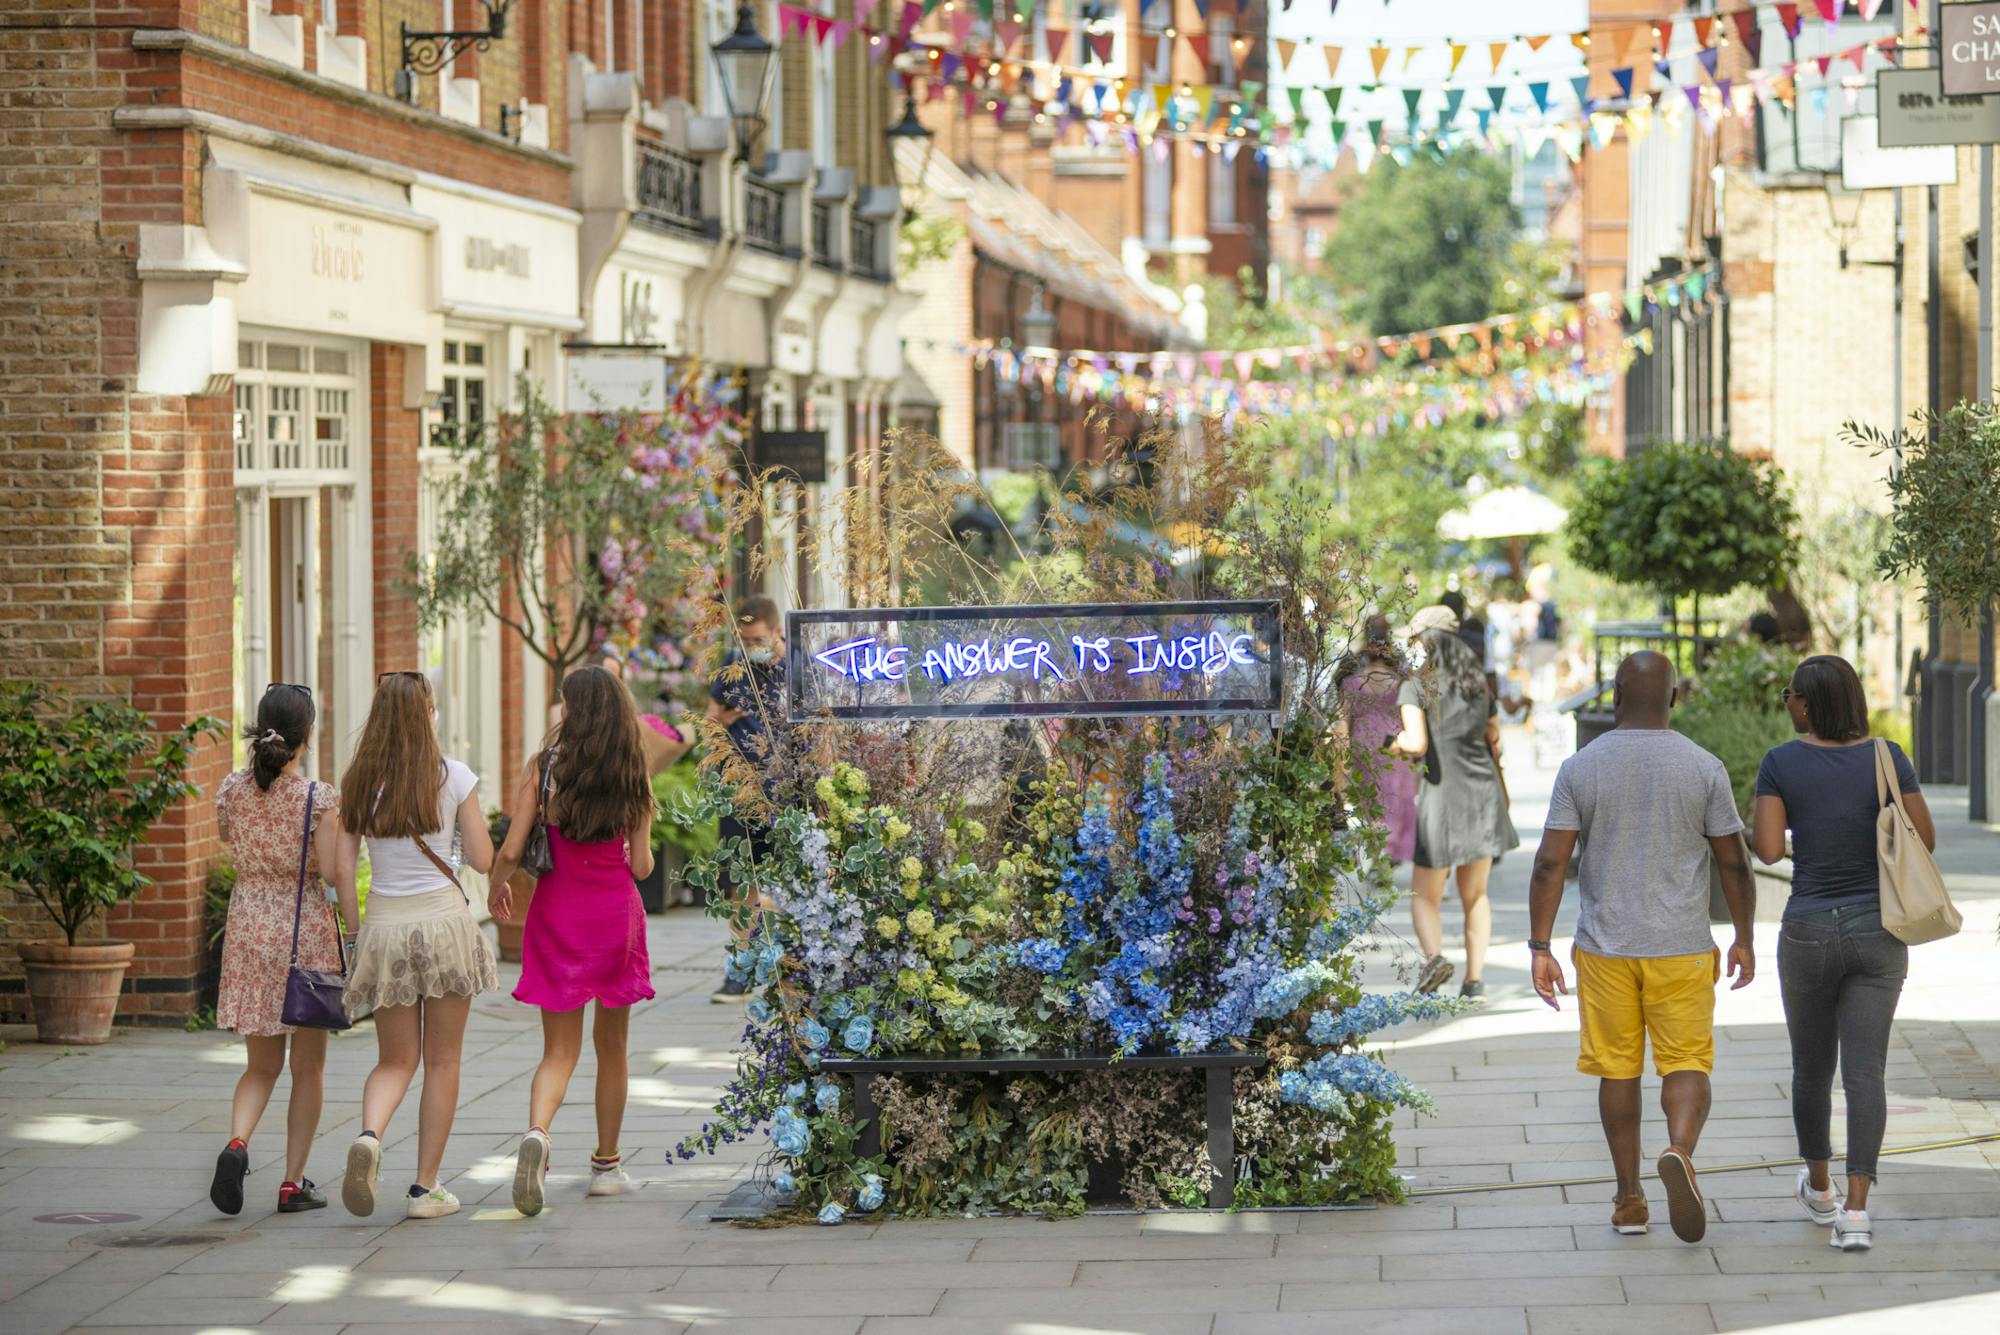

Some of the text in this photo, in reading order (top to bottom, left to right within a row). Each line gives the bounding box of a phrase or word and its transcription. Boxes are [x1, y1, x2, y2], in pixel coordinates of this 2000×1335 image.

[921, 638, 1064, 680] ANSWER
[1071, 634, 1111, 673] IS
[1124, 630, 1256, 674] INSIDE
